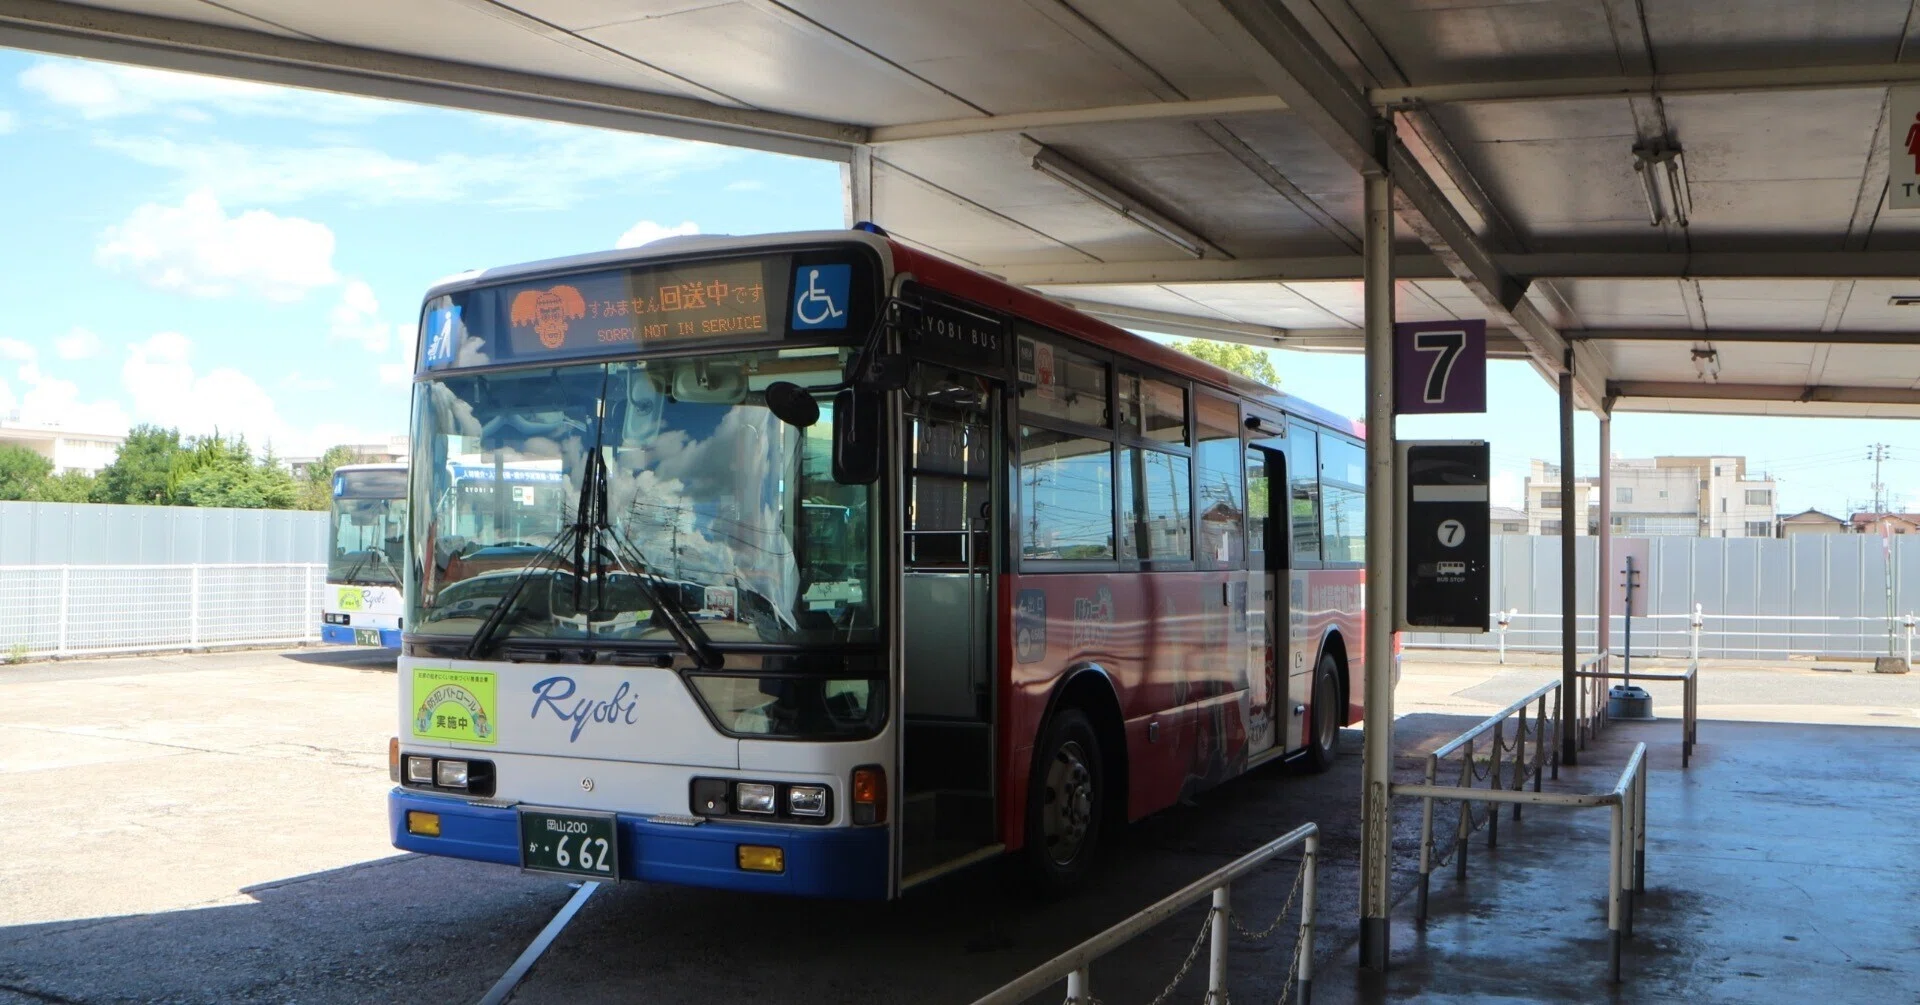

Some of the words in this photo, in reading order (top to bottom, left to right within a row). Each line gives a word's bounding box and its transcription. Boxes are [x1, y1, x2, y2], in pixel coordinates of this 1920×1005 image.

[1901, 183, 1920, 197] T
[597, 326, 637, 342] SORRY
[644, 323, 669, 339] NOT
[677, 321, 694, 335] IN
[701, 315, 763, 334] SERVICE
[921, 315, 962, 341] YOBI
[971, 329, 997, 350] BUS
[1414, 330, 1466, 404] 7
[1445, 524, 1459, 544] 7
[426, 687, 477, 712] 防犯パトロール
[529, 675, 640, 743] Ryobi
[436, 714, 468, 731] 実施中
